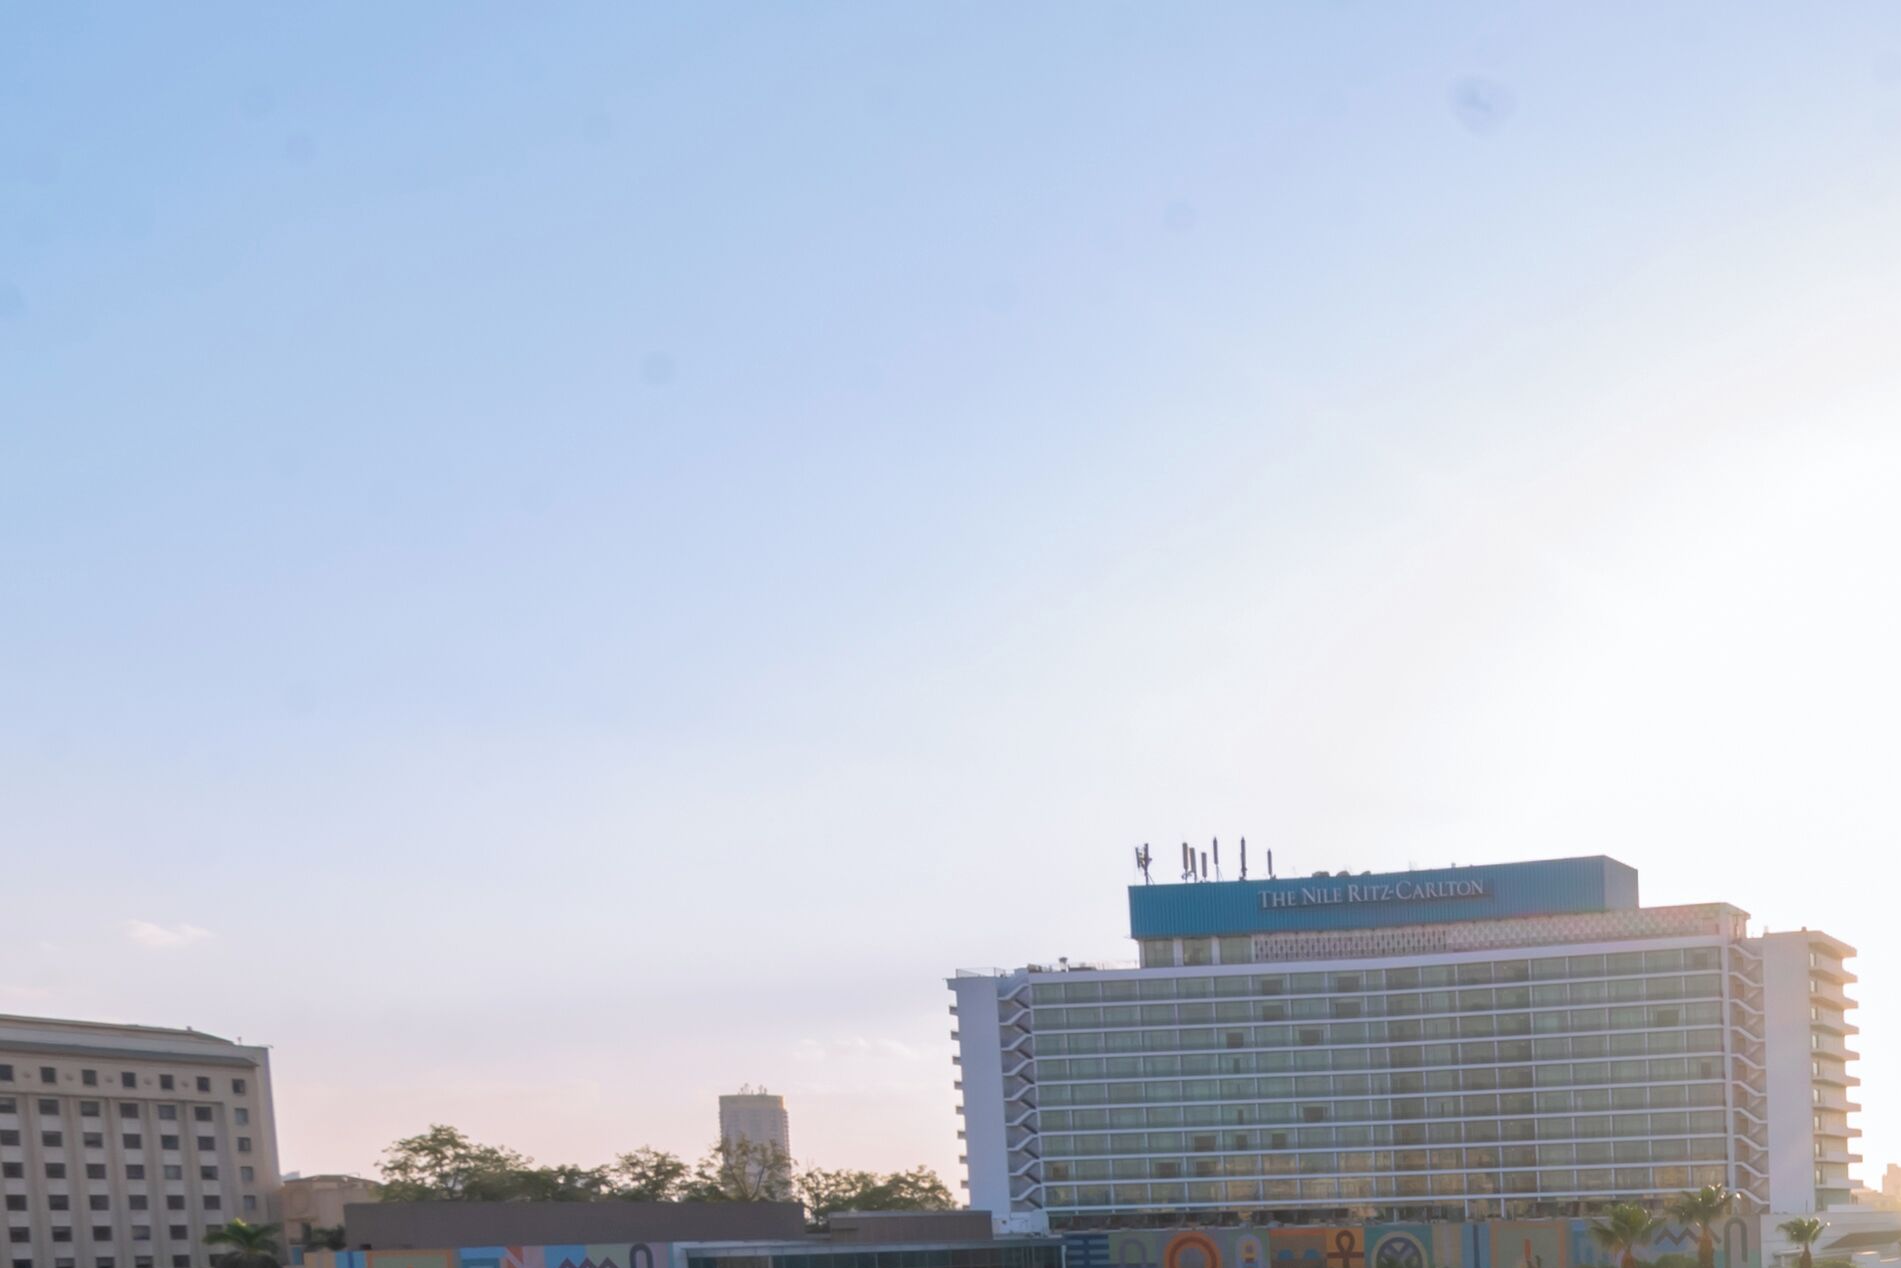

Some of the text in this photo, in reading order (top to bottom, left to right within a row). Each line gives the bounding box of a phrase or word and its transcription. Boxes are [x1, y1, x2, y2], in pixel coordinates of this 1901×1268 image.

[1258, 880, 1484, 908] THE NILE RITZ-CARLTON
